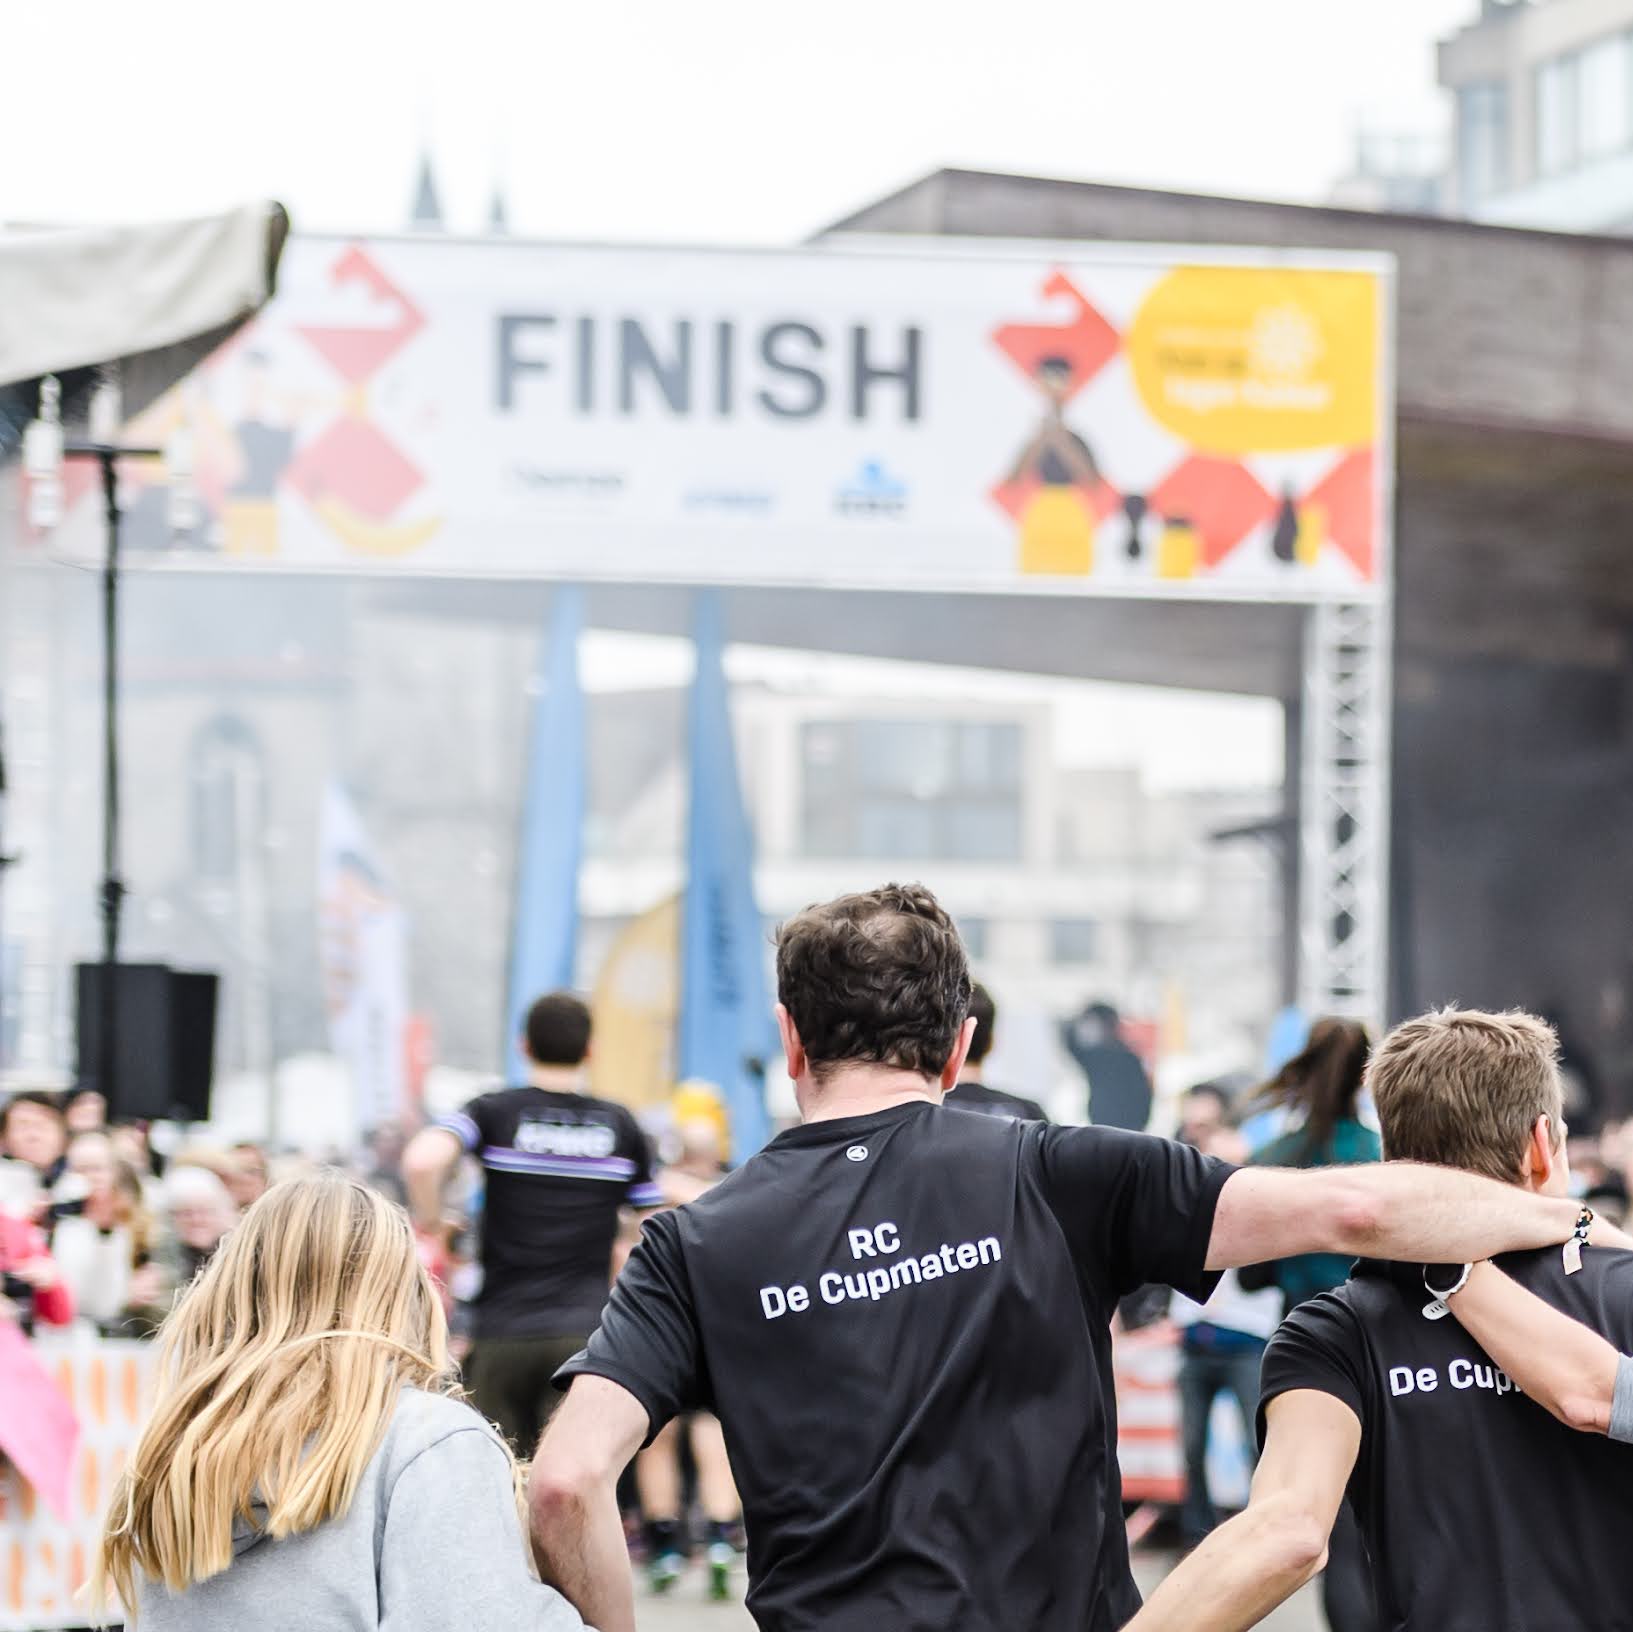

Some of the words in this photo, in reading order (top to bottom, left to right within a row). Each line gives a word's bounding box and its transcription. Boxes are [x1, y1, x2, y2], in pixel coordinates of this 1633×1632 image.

[494, 313, 923, 421] FINISH
[847, 1222, 901, 1260] RC
[759, 1284, 810, 1320] De
[819, 1236, 1002, 1305] Cupmaten
[1389, 1365, 1438, 1396] De
[1449, 1358, 1521, 1396] Cup
